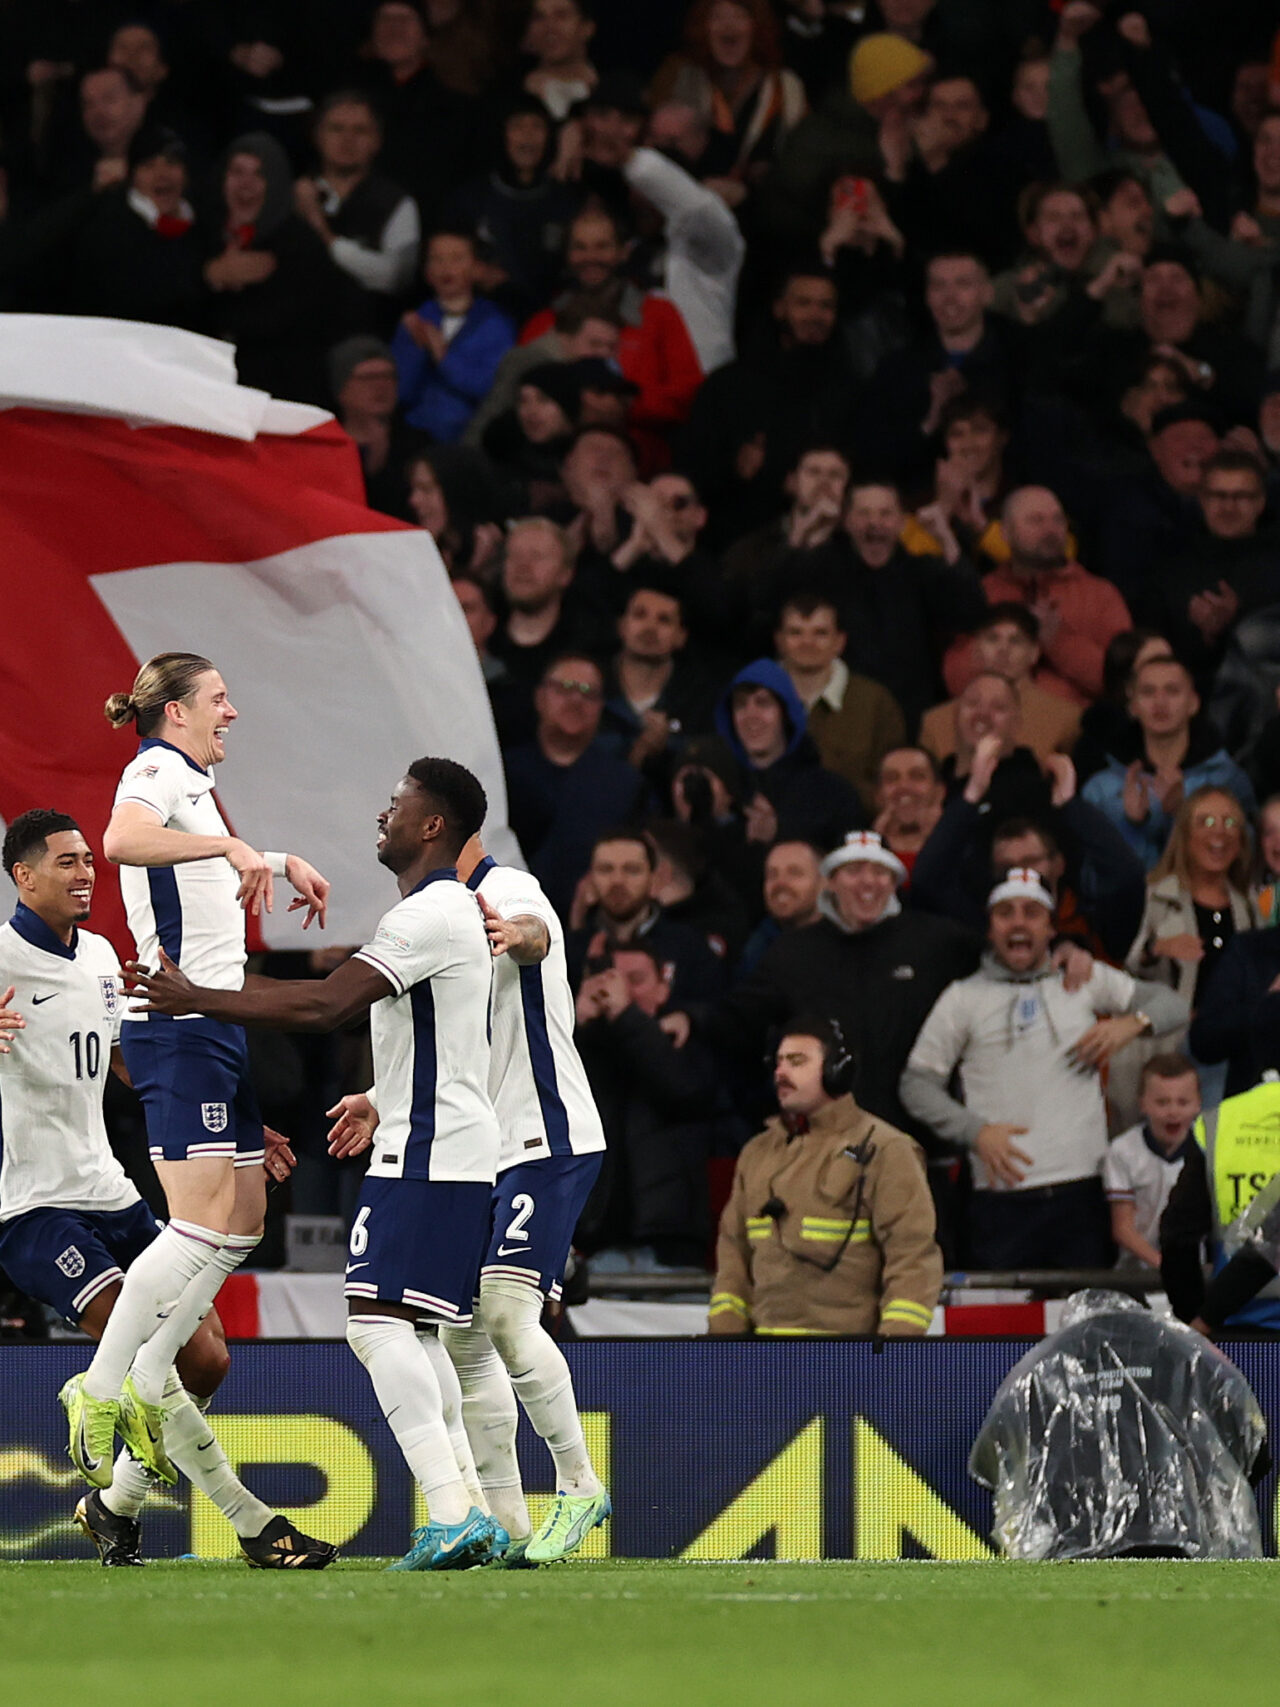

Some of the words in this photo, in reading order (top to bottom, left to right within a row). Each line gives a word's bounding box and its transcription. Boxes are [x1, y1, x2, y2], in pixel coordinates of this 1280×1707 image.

[68, 1030, 100, 1081] 10
[349, 1206, 372, 1257] 6
[505, 1193, 535, 1242] 2
